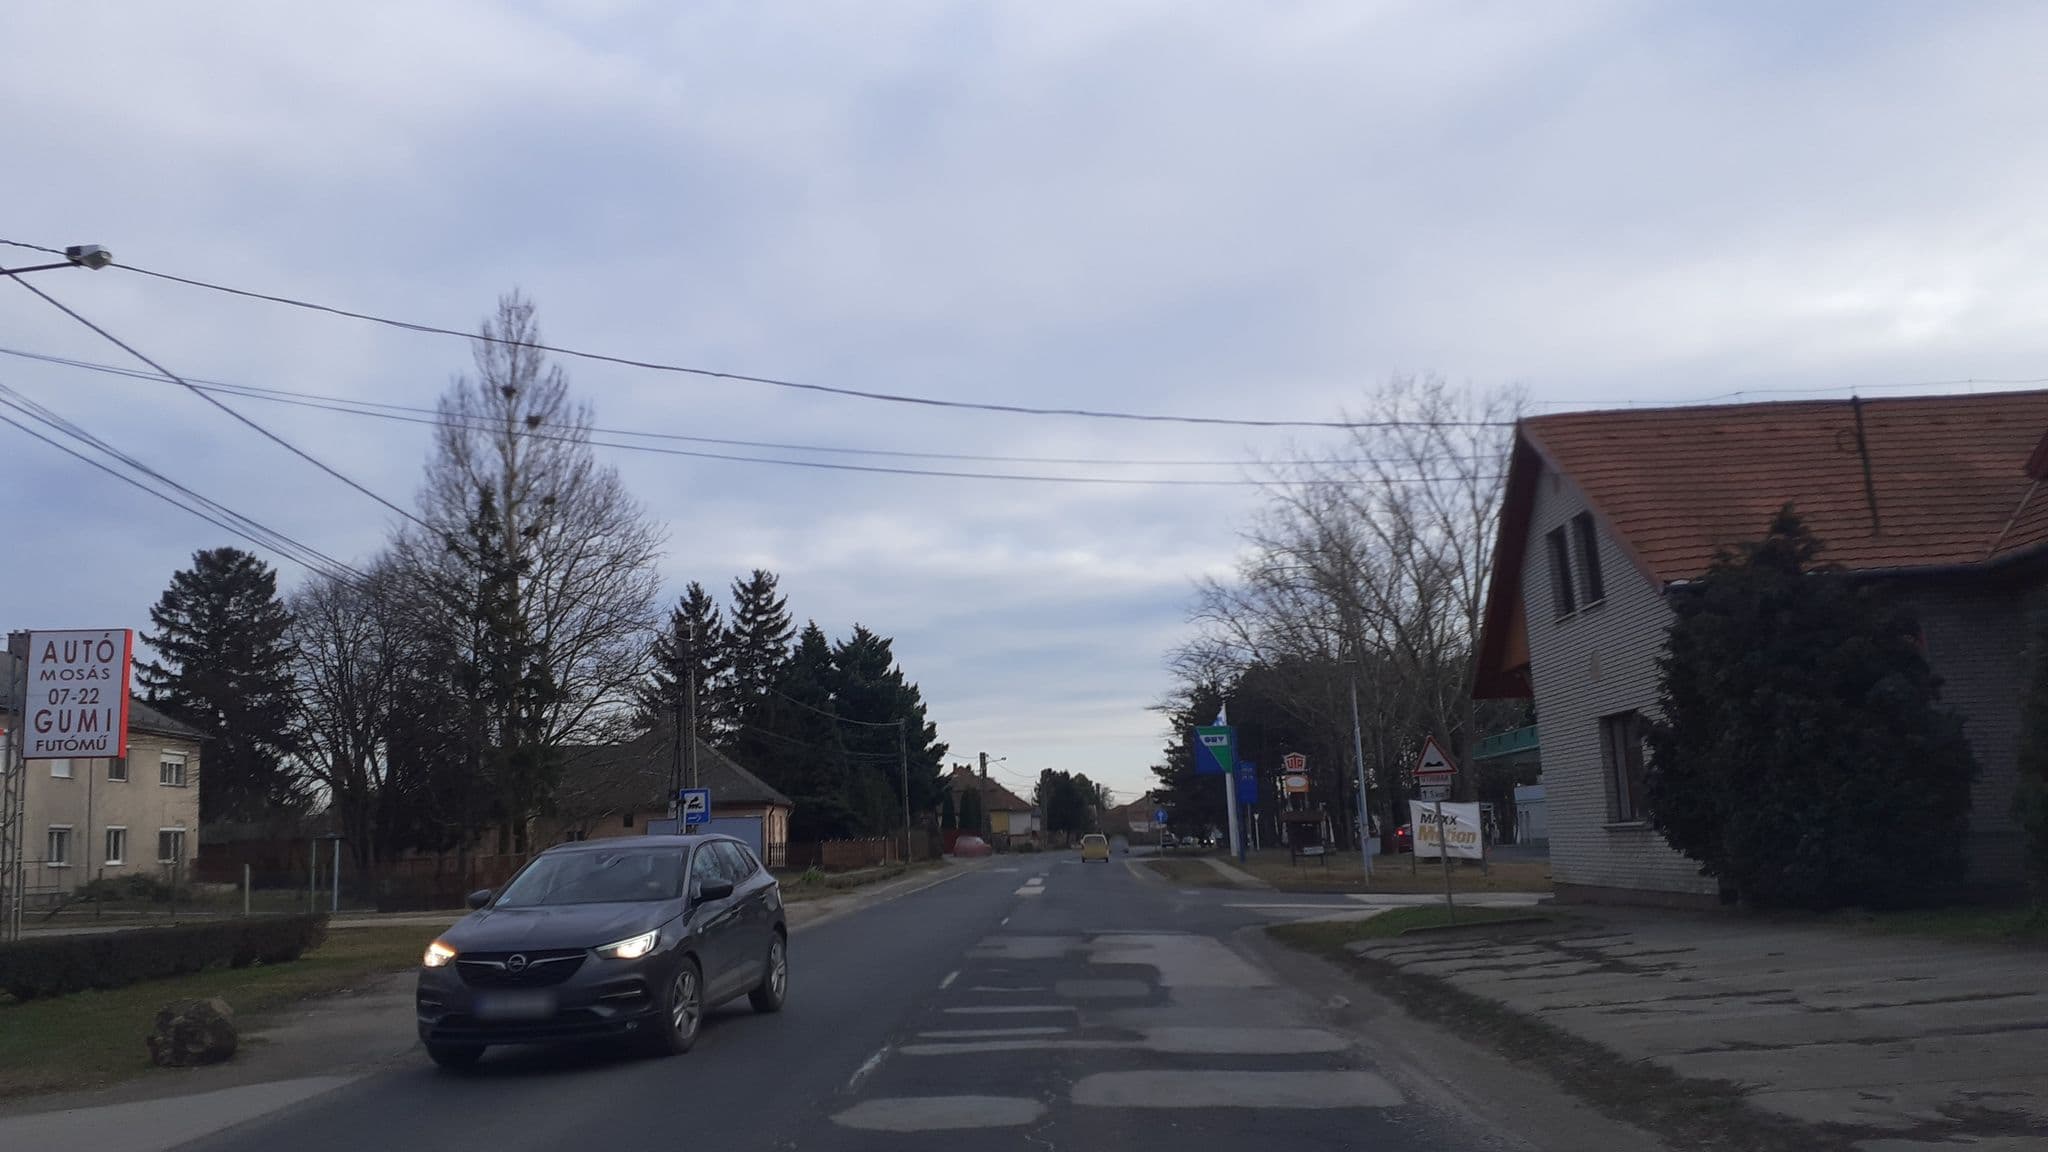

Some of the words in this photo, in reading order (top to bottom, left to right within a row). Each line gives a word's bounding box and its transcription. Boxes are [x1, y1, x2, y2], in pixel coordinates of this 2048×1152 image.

[42, 633, 115, 664] AUTÓ
[40, 665, 111, 681] MOSÁS
[48, 688, 100, 705] 07-22
[34, 708, 112, 734] GUMI
[36, 735, 108, 752] FUTÓMŰ
